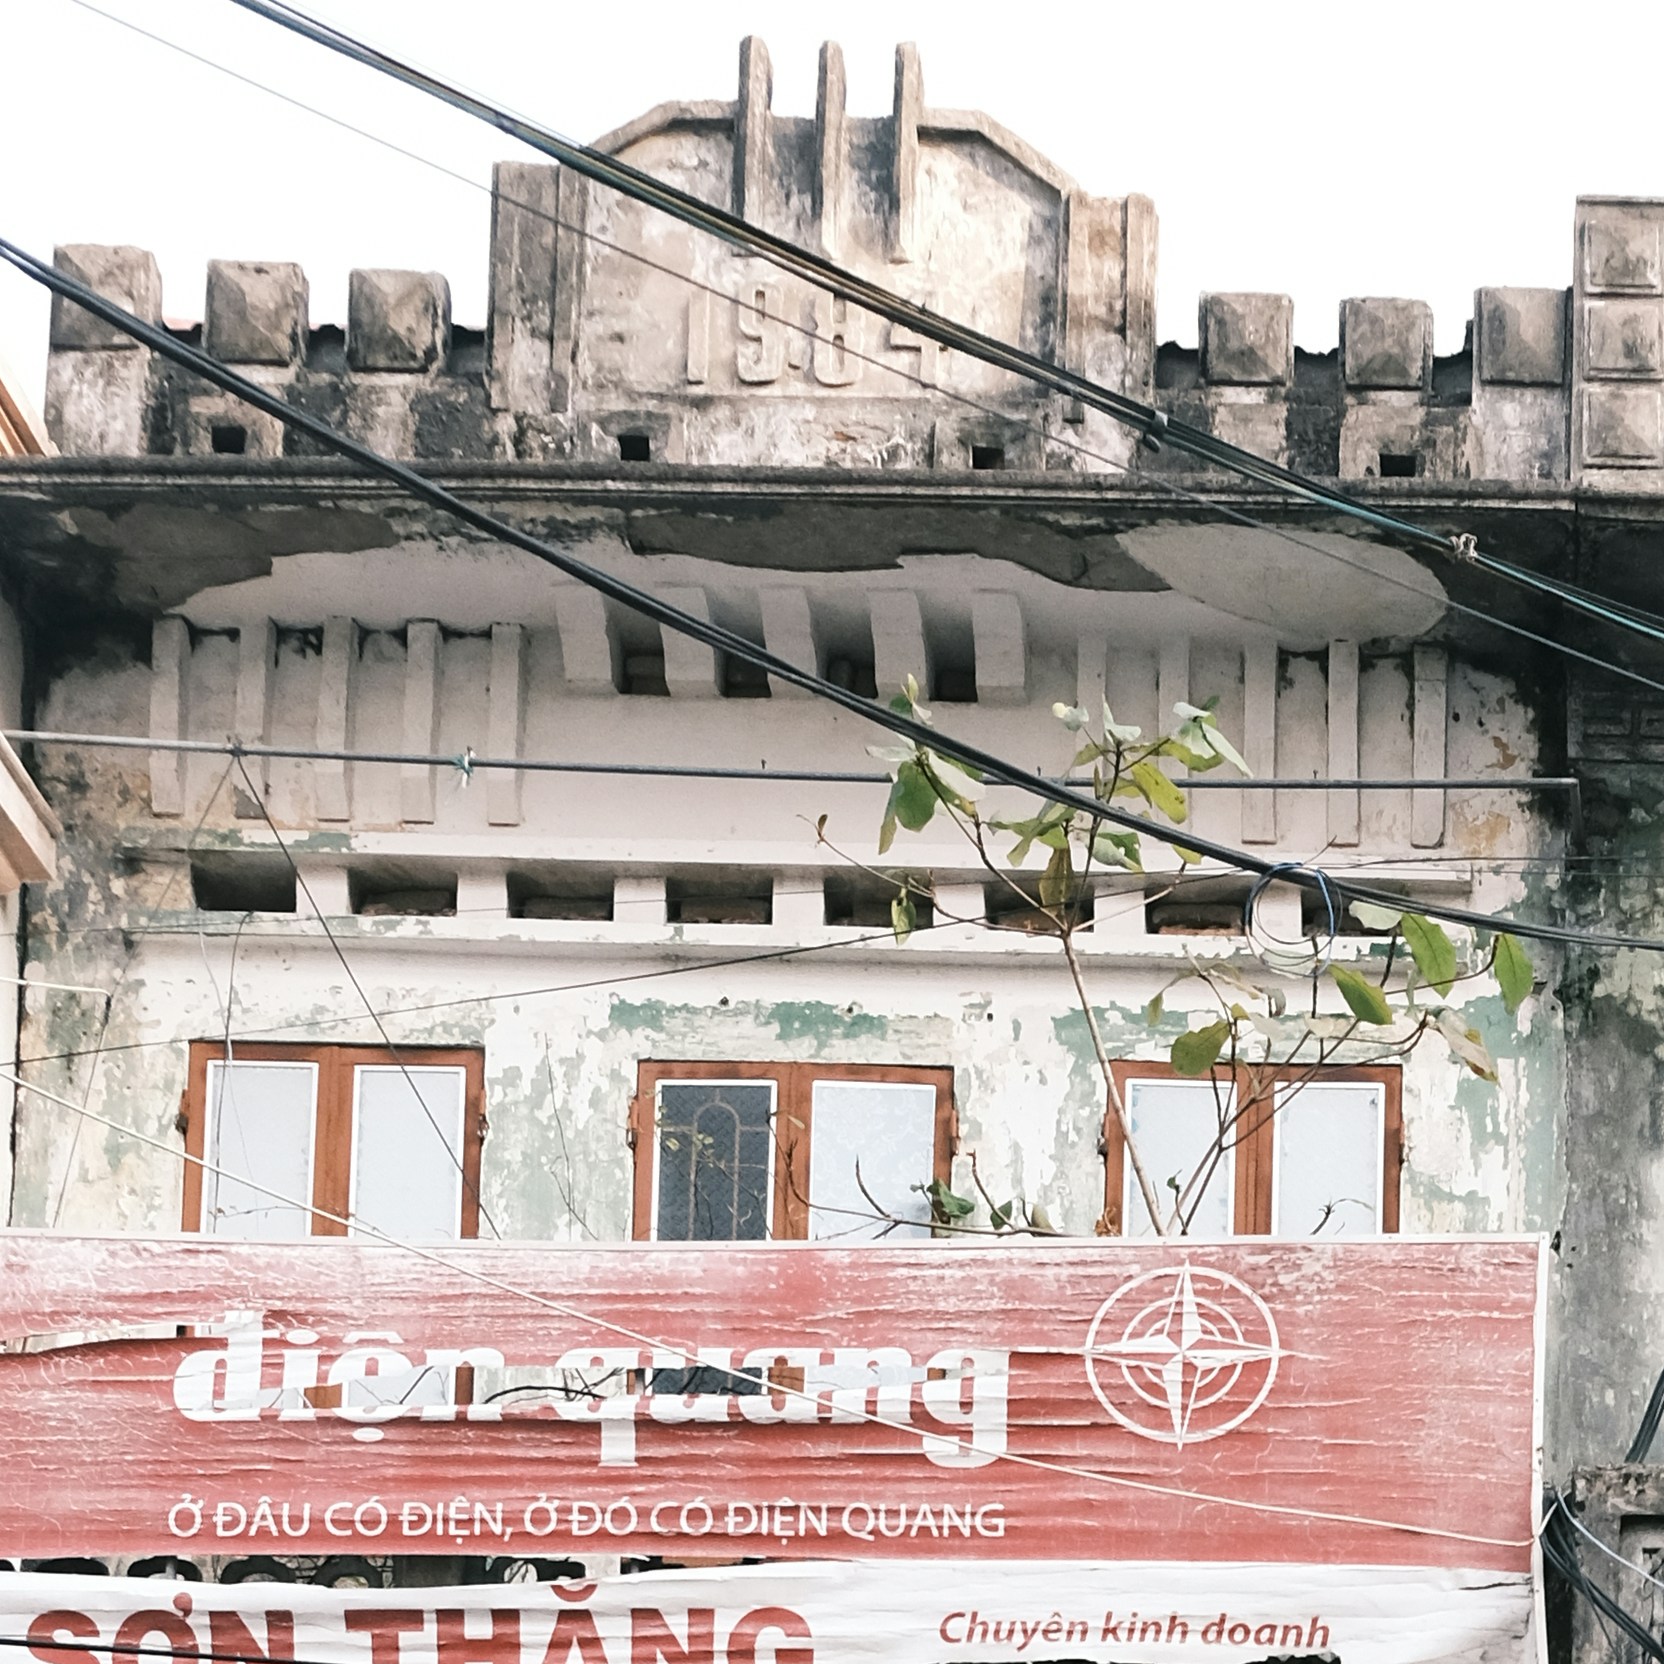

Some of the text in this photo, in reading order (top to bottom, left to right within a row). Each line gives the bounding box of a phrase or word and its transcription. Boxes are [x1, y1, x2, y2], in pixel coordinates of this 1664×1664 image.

[168, 1493, 1006, 1545] Ở ĐÂU CÓ ĐIỆN, Ở ĐÓ CÓ ĐIỆN QUANG
[938, 1611, 1331, 1652] Chuyên kinh doanh
